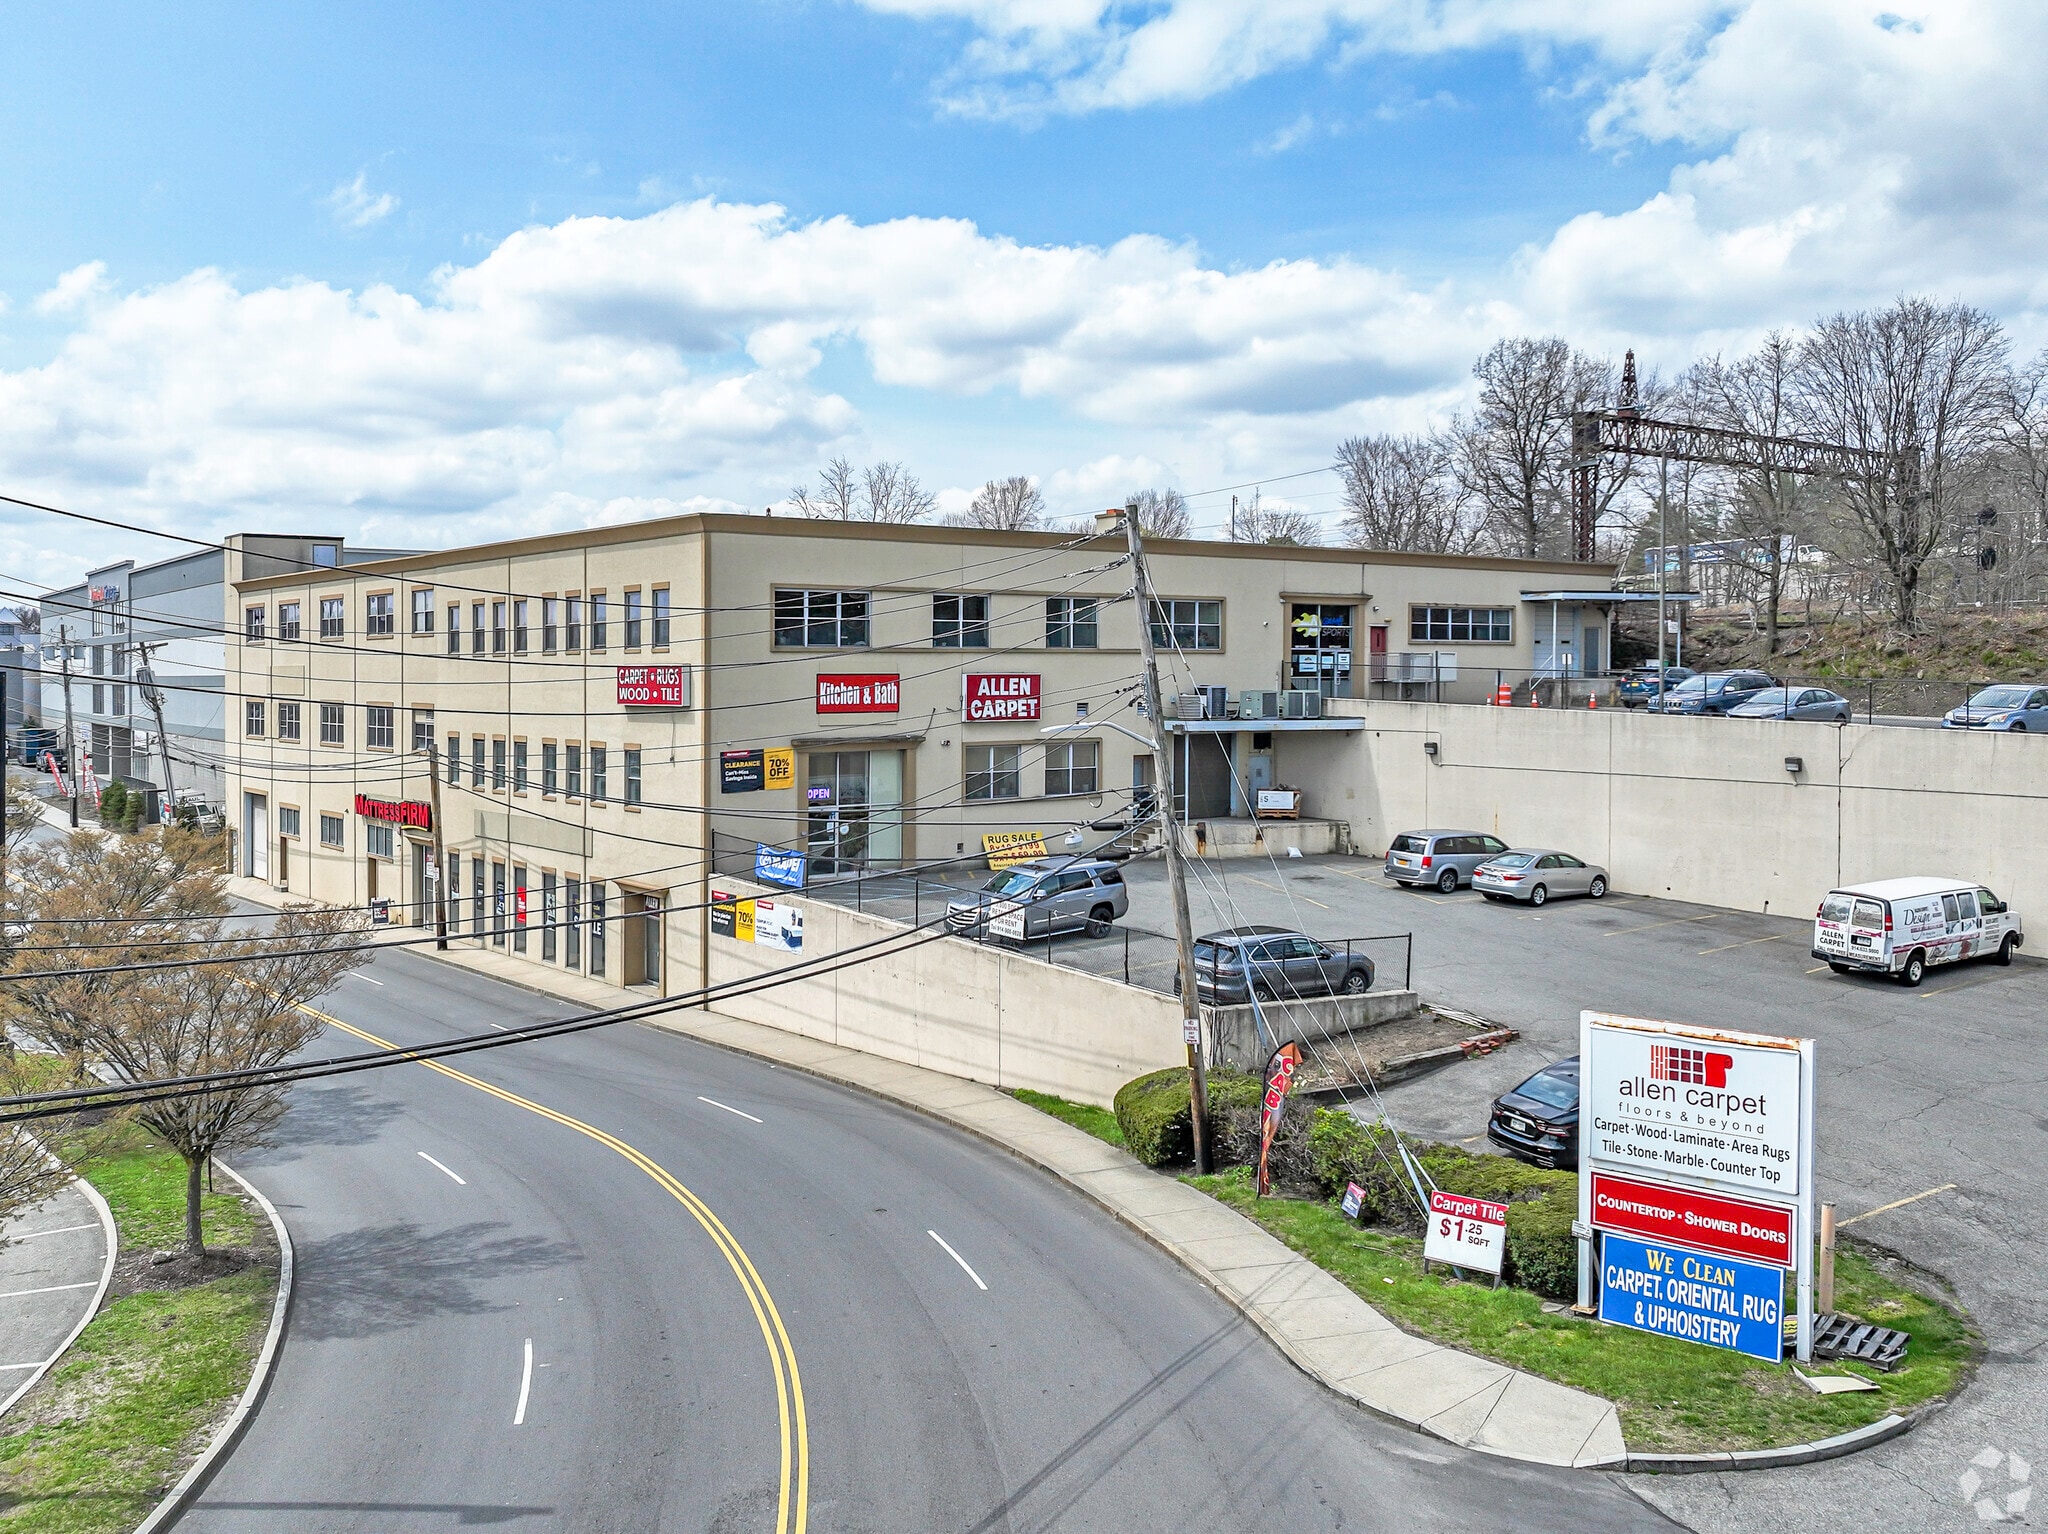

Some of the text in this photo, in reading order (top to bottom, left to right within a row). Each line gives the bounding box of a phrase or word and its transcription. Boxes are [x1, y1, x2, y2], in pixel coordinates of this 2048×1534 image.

[618, 668, 679, 684] CARPET RUGS
[619, 688, 680, 700] WOOD TILE
[820, 682, 897, 705] Kitchen & Bath
[978, 677, 1030, 696] ALLEN
[970, 700, 1038, 718] CARPET
[725, 760, 760, 768] CLEARANCE
[769, 758, 789, 768] 70%
[770, 768, 789, 777] OFF
[808, 788, 830, 799] OPEN
[988, 833, 1036, 844] RUG SALE
[738, 912, 753, 924] 70%
[1820, 937, 1845, 948] CARPET
[1822, 930, 1843, 940] ALLEN
[1620, 1076, 1766, 1116] allen carpet
[1618, 1102, 1764, 1134] floors & beyond
[1594, 1117, 1790, 1162] Carpet Wood Laminate Area Rugs
[1602, 1139, 1781, 1184] Tile Stone Marble Counter Top
[1433, 1194, 1504, 1221] Carpet Tile
[1597, 1193, 1786, 1244] COUNTERTOP SHOWER DOORS
[1468, 1236, 1490, 1247] SQFT
[1646, 1248, 1736, 1287] WE CLEAN
[1606, 1265, 1777, 1324] CARPET, ORIENTAL RUG
[1634, 1301, 1741, 1347] & UPHOISTERY
